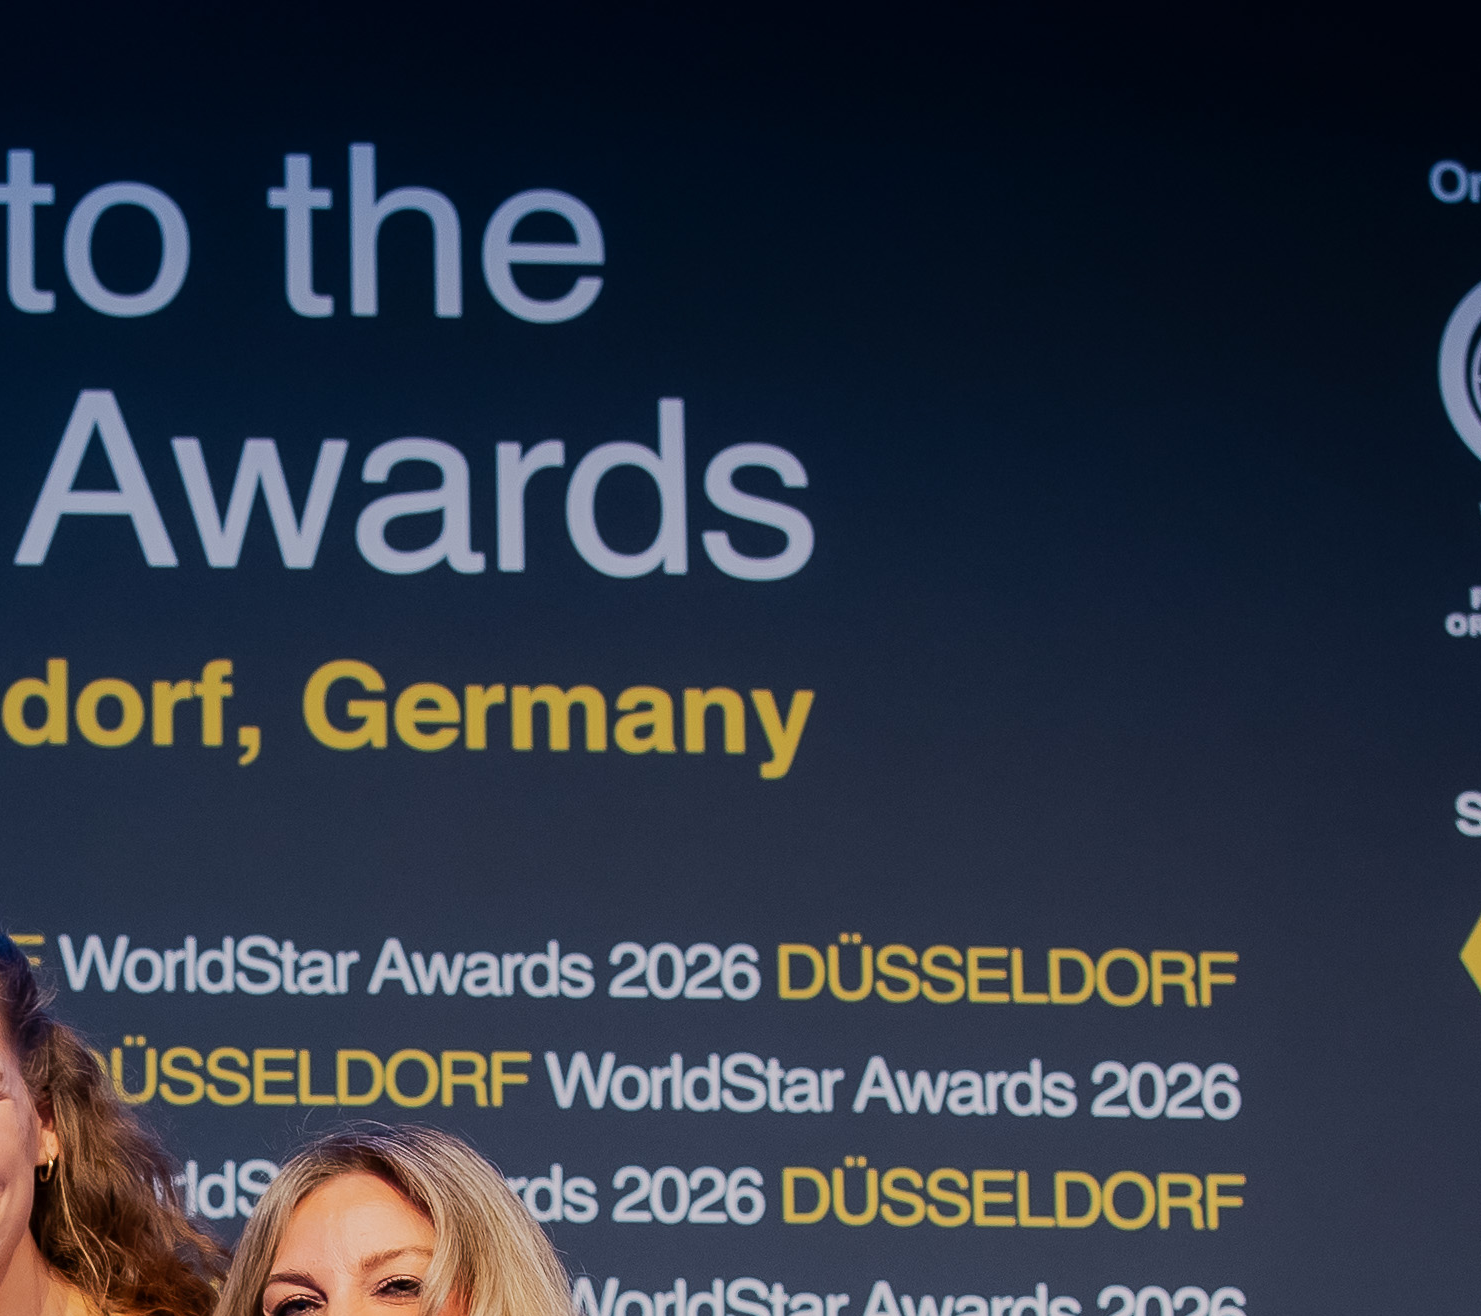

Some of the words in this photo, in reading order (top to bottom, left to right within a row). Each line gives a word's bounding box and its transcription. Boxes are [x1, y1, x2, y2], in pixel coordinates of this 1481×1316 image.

[268, 143, 604, 323] the
[14, 390, 814, 581] Awards
[303, 660, 814, 779] Germany
[58, 935, 360, 994] WorldStar
[368, 938, 595, 998] Awards
[609, 942, 761, 1000] 2026
[778, 933, 1238, 1006] DÜSSELDORF
[88, 1034, 532, 1107] ÜSSELDORF
[545, 1052, 844, 1113] WorldStar
[853, 1056, 1077, 1117] Awards
[1091, 1061, 1241, 1120] 2026
[612, 1166, 765, 1224] 2026
[783, 1156, 1246, 1230] DÜSSELDORF
